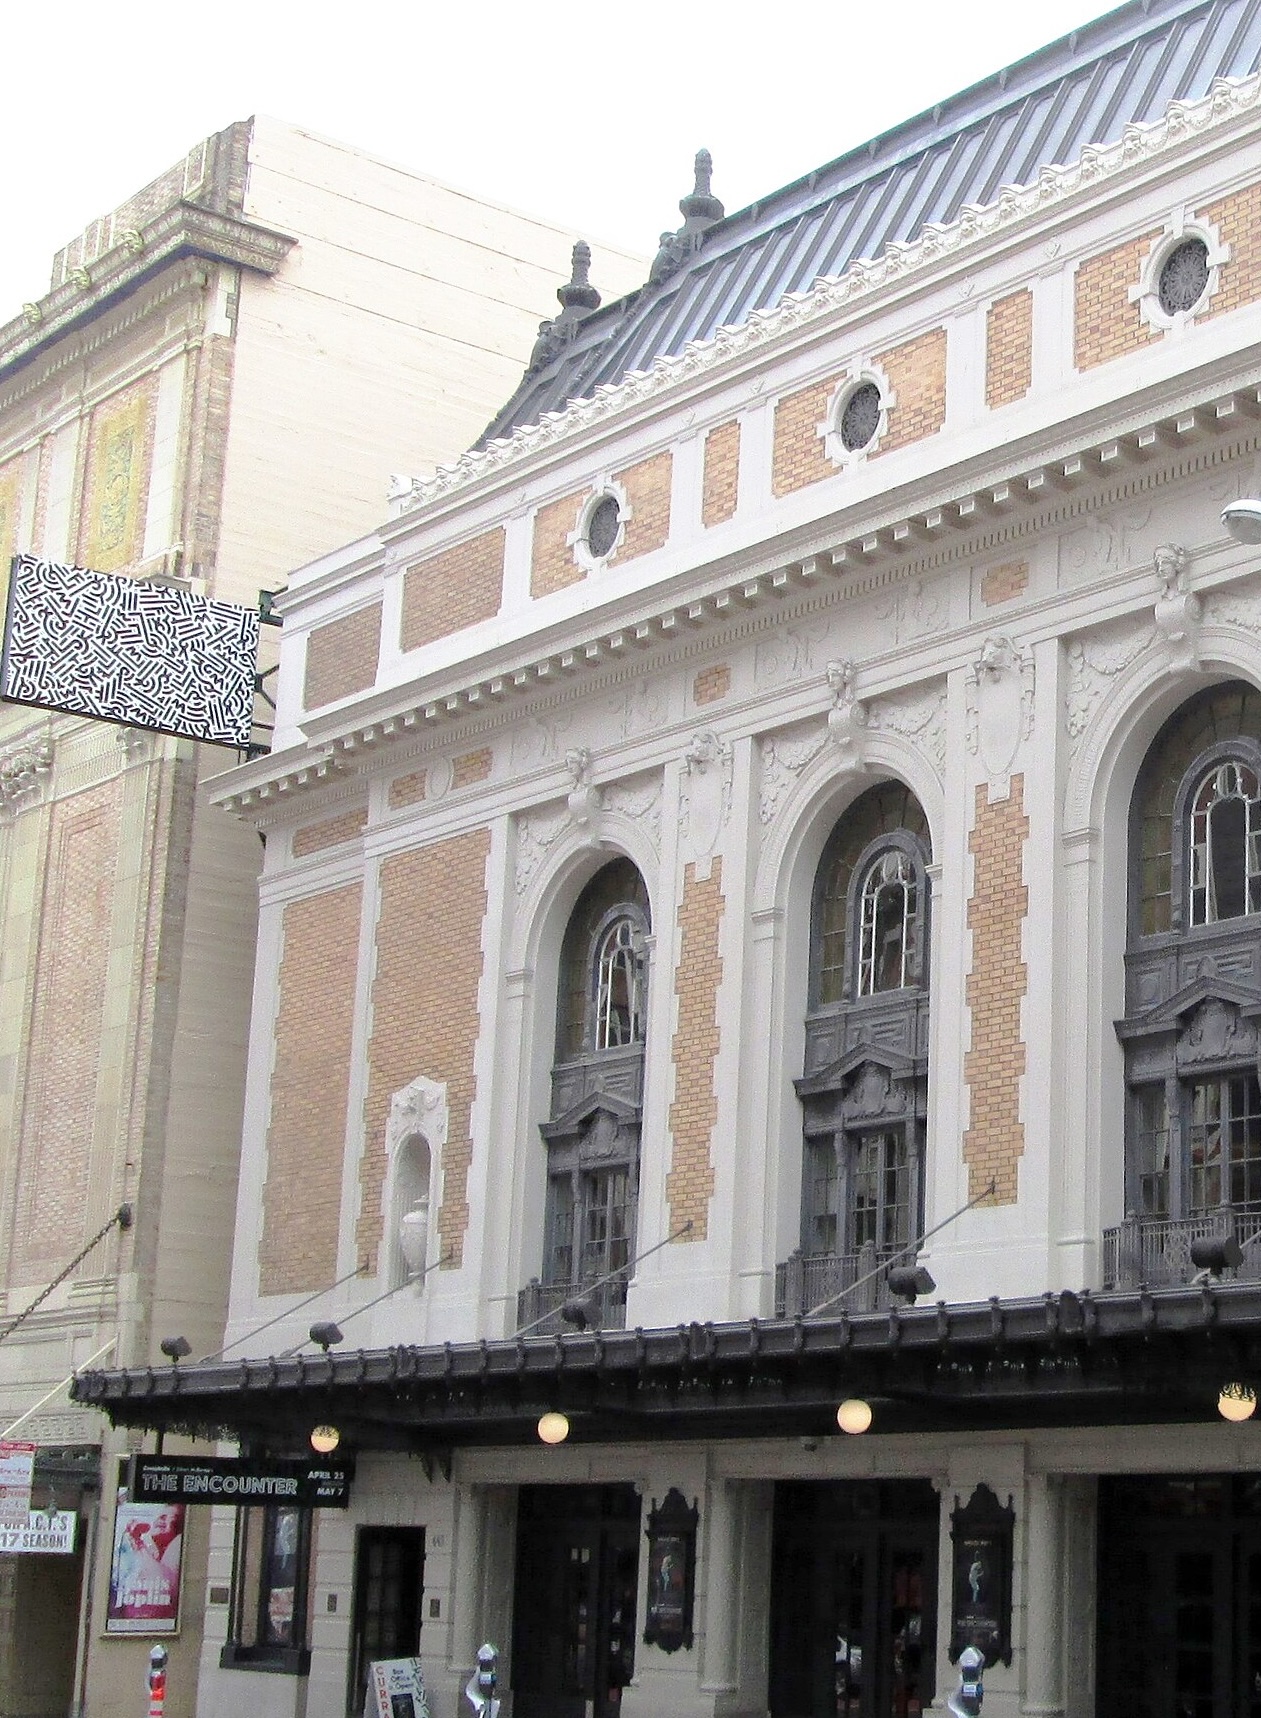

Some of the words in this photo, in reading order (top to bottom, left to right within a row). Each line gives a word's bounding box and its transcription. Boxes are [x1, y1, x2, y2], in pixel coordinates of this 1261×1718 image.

[308, 1471, 331, 1480] APRIL
[334, 1472, 344, 1480] 25
[142, 1473, 178, 1492] THE
[183, 1475, 298, 1495] ENCOUNTER
[317, 1487, 335, 1496] MAY
[338, 1488, 344, 1496] 7
[22, 1533, 68, 1548] SEASON!
